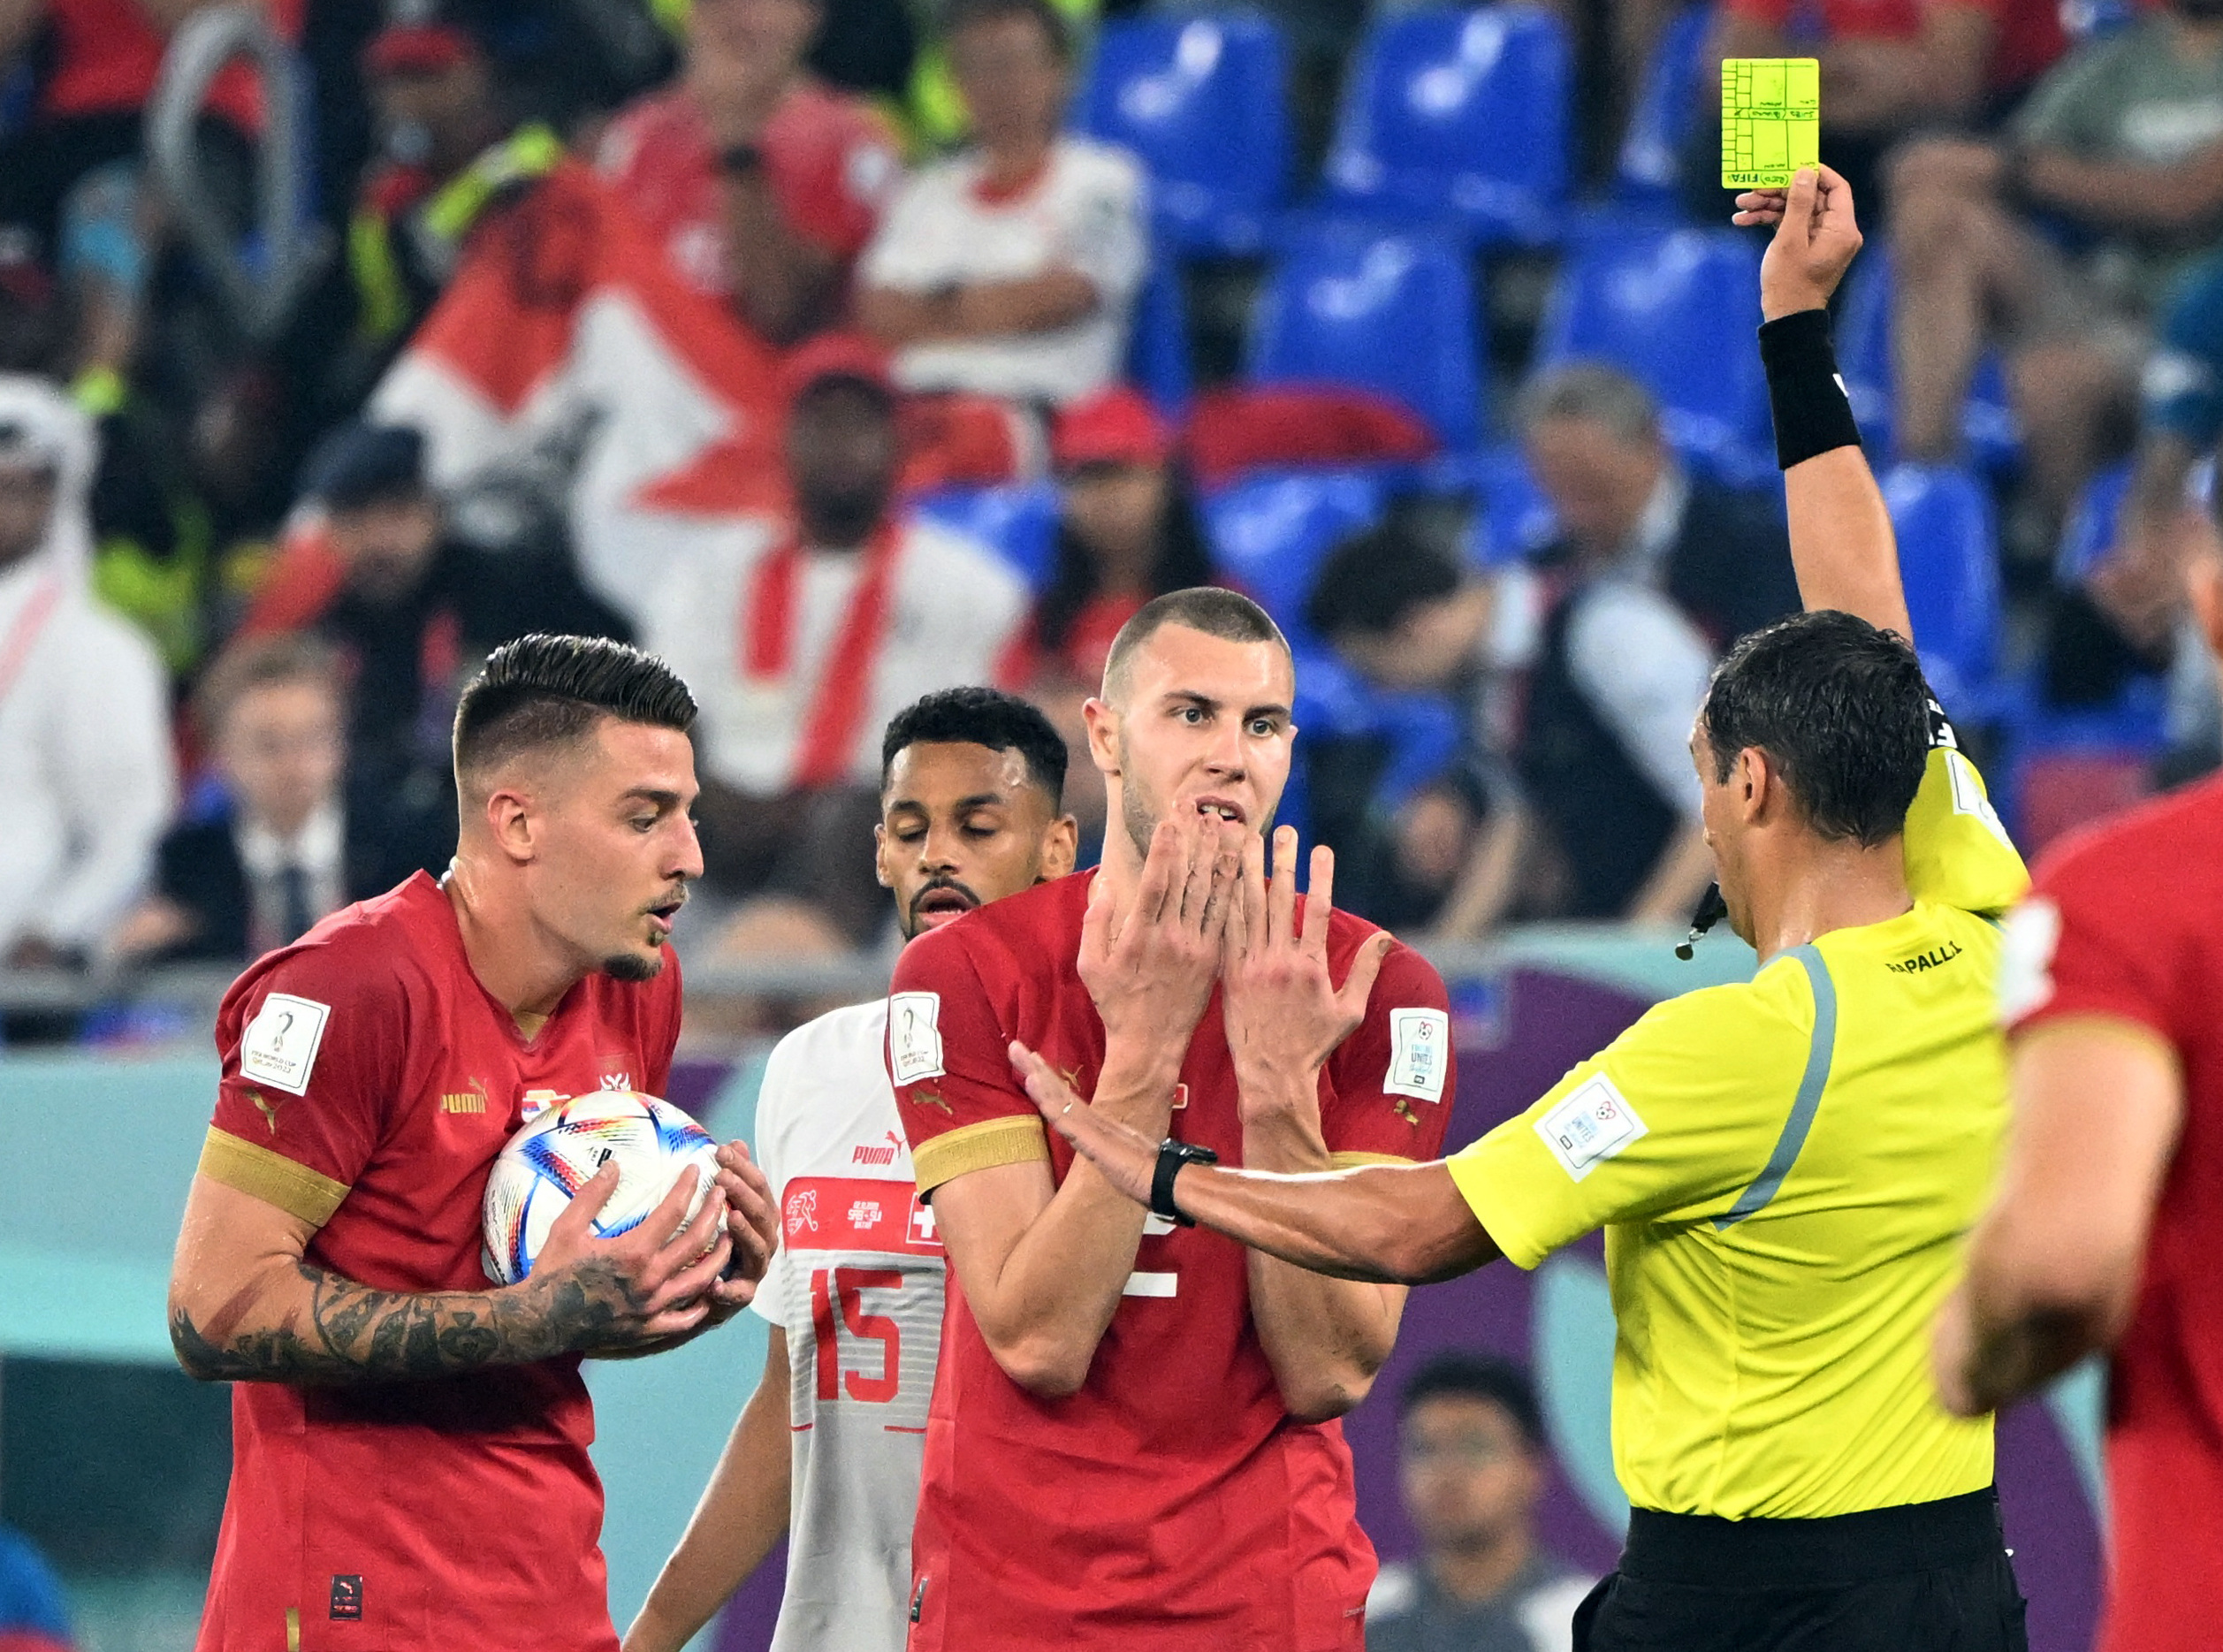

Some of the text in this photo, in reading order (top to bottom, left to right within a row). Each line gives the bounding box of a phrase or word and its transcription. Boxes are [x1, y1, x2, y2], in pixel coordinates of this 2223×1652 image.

[1732, 173, 1758, 182] FIFA
[440, 1092, 486, 1114] PUMA
[852, 1145, 895, 1165] PUMA
[810, 1267, 903, 1404] 15
